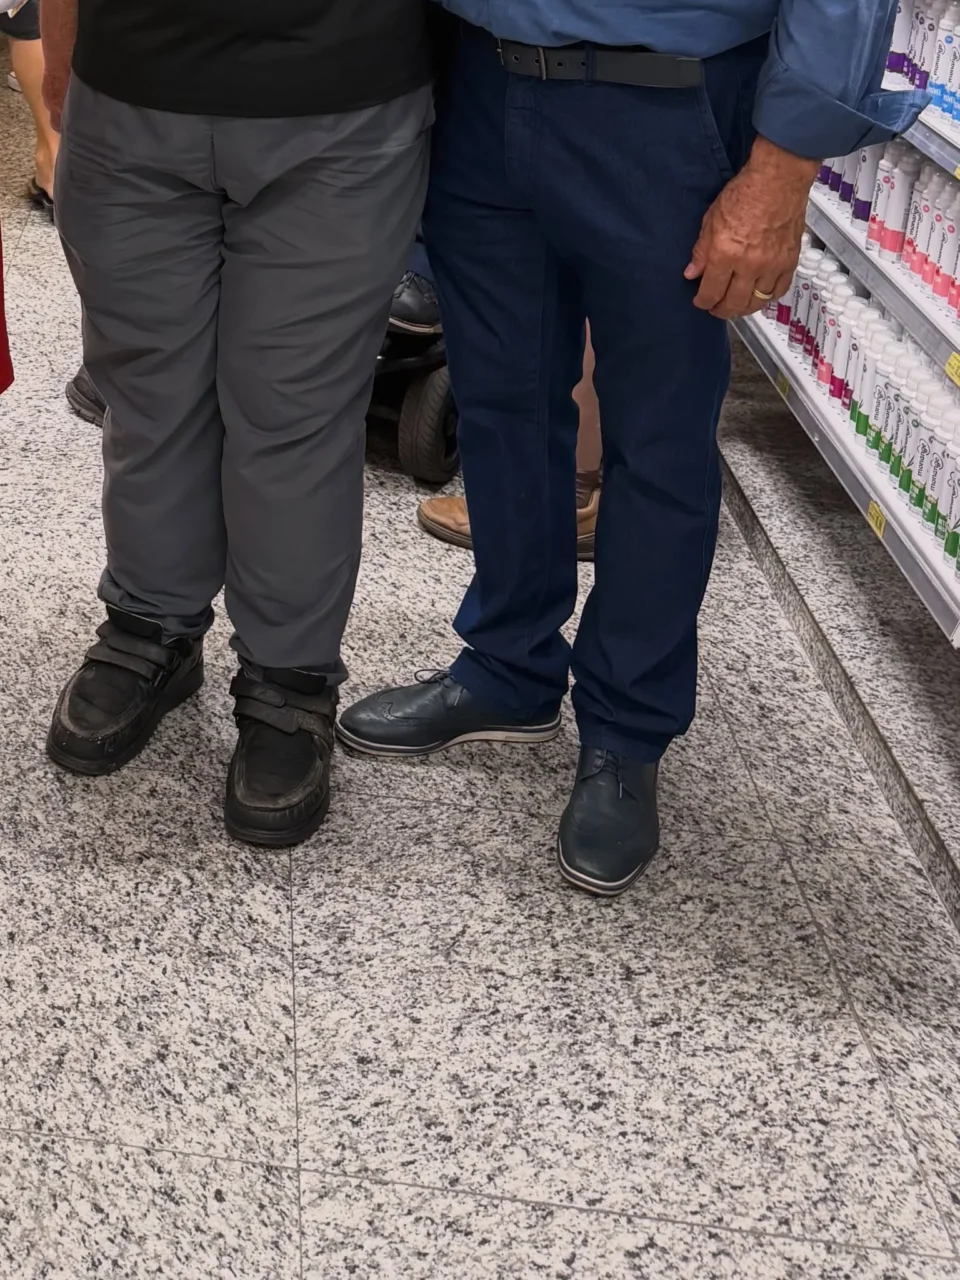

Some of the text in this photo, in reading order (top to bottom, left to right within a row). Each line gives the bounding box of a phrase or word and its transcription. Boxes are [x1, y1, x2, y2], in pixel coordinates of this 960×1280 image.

[873, 387, 885, 421] monange
[917, 441, 930, 477] monange
[930, 455, 943, 492] monange
